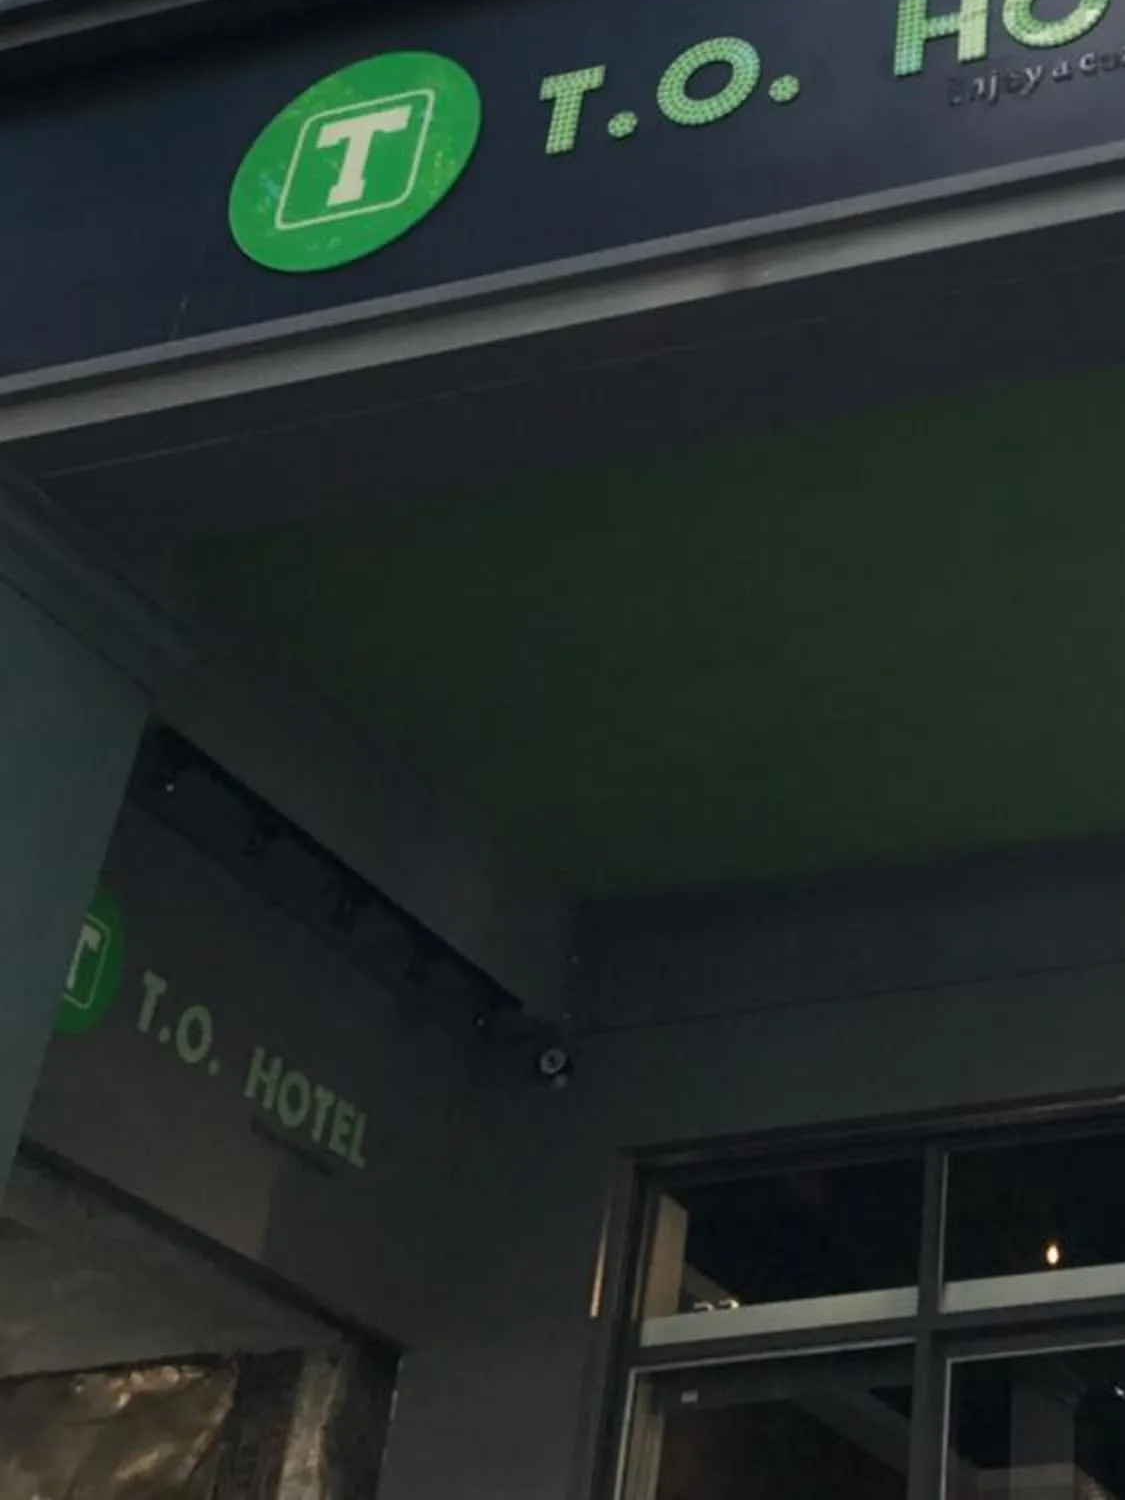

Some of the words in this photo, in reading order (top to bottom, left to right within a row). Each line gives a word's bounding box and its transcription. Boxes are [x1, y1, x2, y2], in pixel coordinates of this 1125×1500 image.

[539, 36, 800, 155] T.O.
[316, 105, 410, 207] T
[137, 970, 221, 1075] T.O.
[244, 1045, 367, 1169] HOTEL
